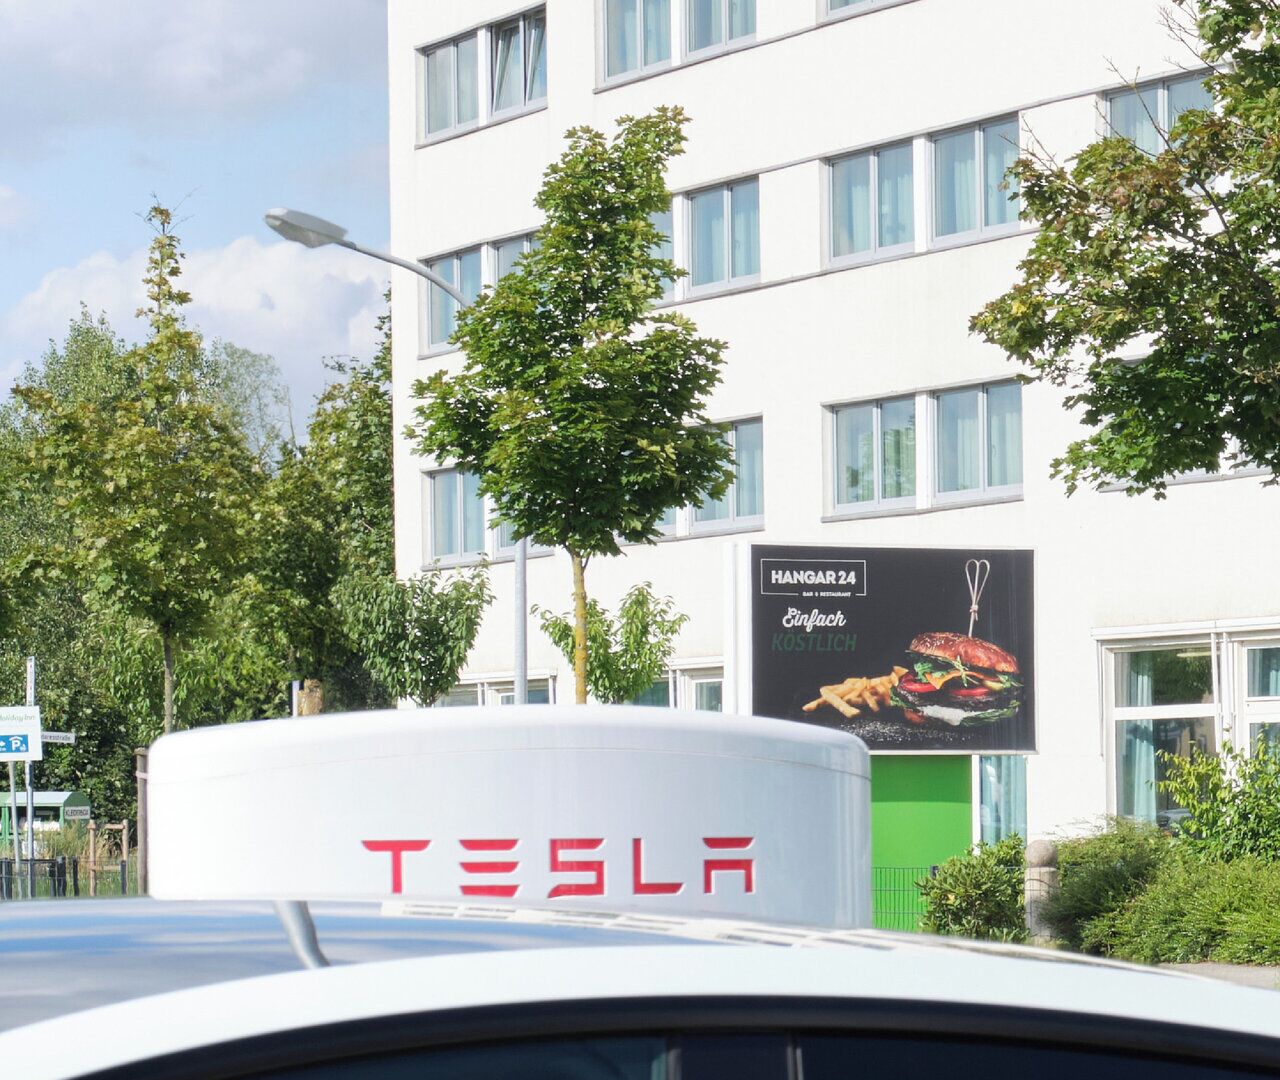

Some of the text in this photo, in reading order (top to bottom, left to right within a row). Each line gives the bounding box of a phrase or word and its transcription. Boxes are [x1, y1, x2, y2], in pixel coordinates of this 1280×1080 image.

[771, 570, 856, 585] HANGAR 24
[782, 606, 846, 632] Einfach
[361, 837, 755, 899] TESLA
